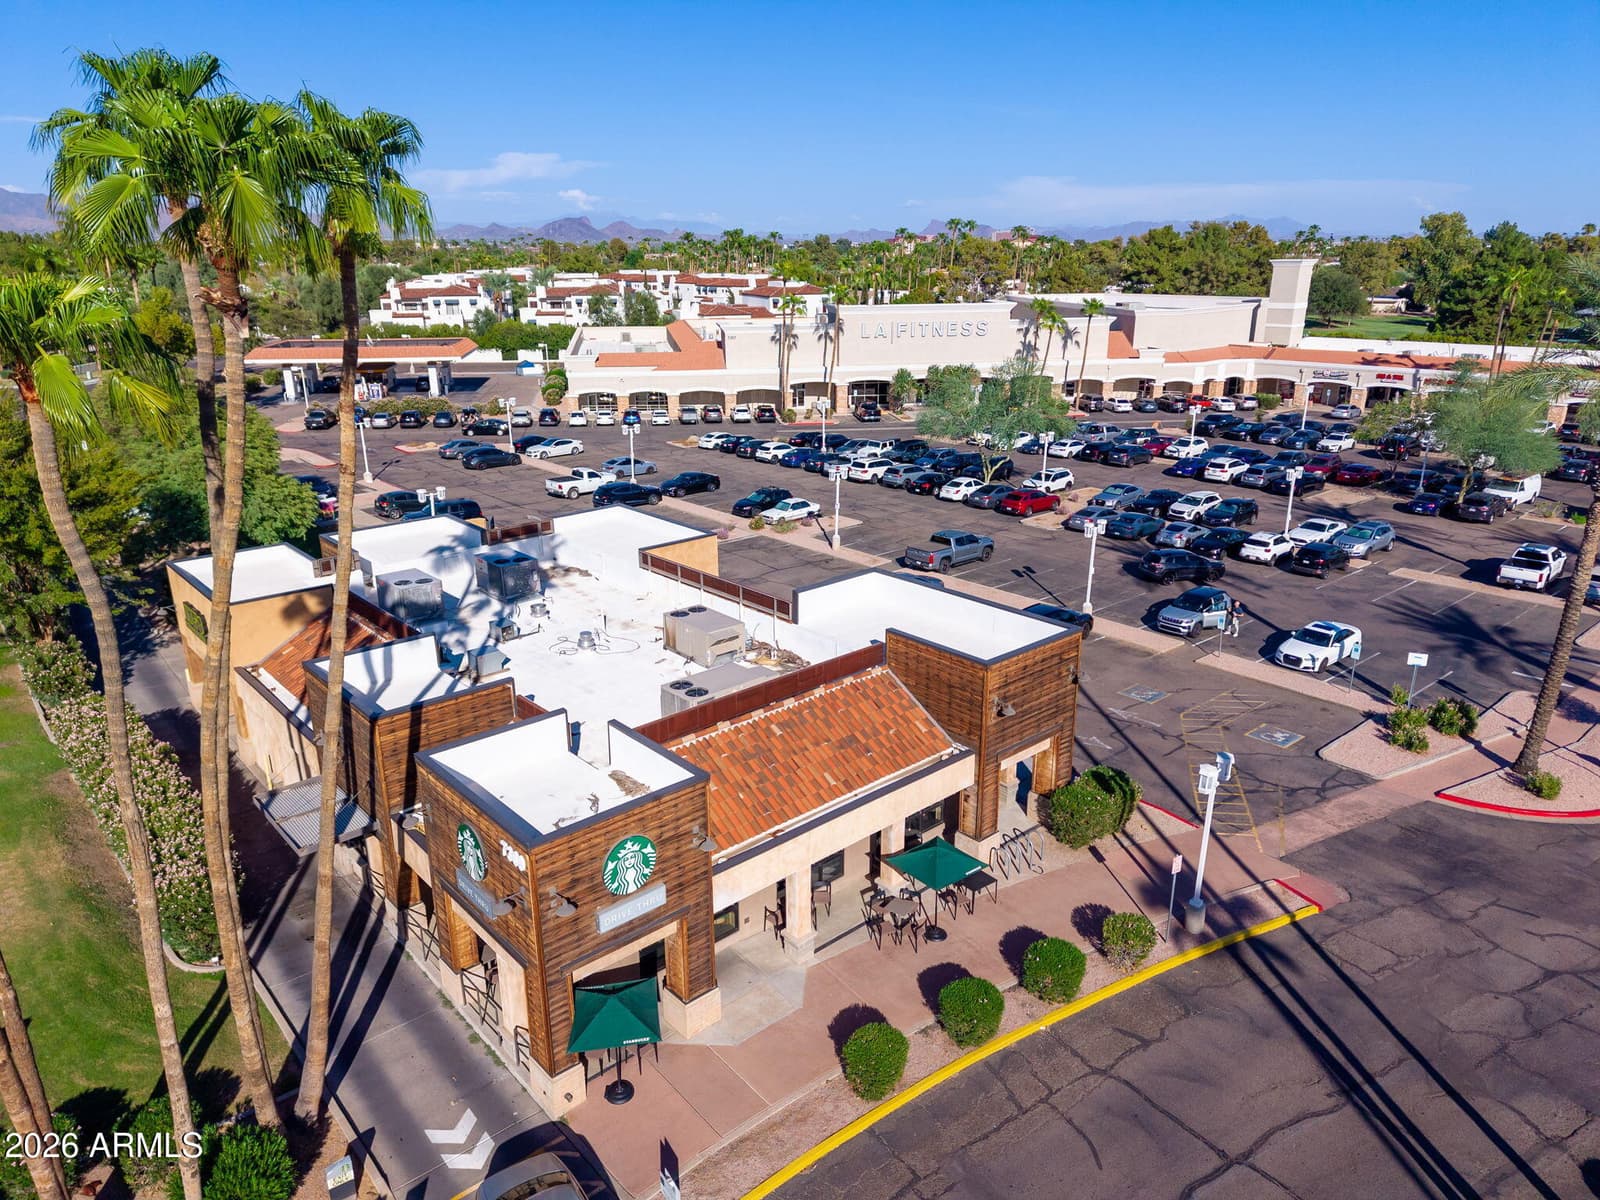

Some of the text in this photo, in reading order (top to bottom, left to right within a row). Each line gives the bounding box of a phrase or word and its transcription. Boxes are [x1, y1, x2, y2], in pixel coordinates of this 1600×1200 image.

[860, 320, 989, 339] LA FITNESS
[604, 895, 663, 926] DRIVE THRU
